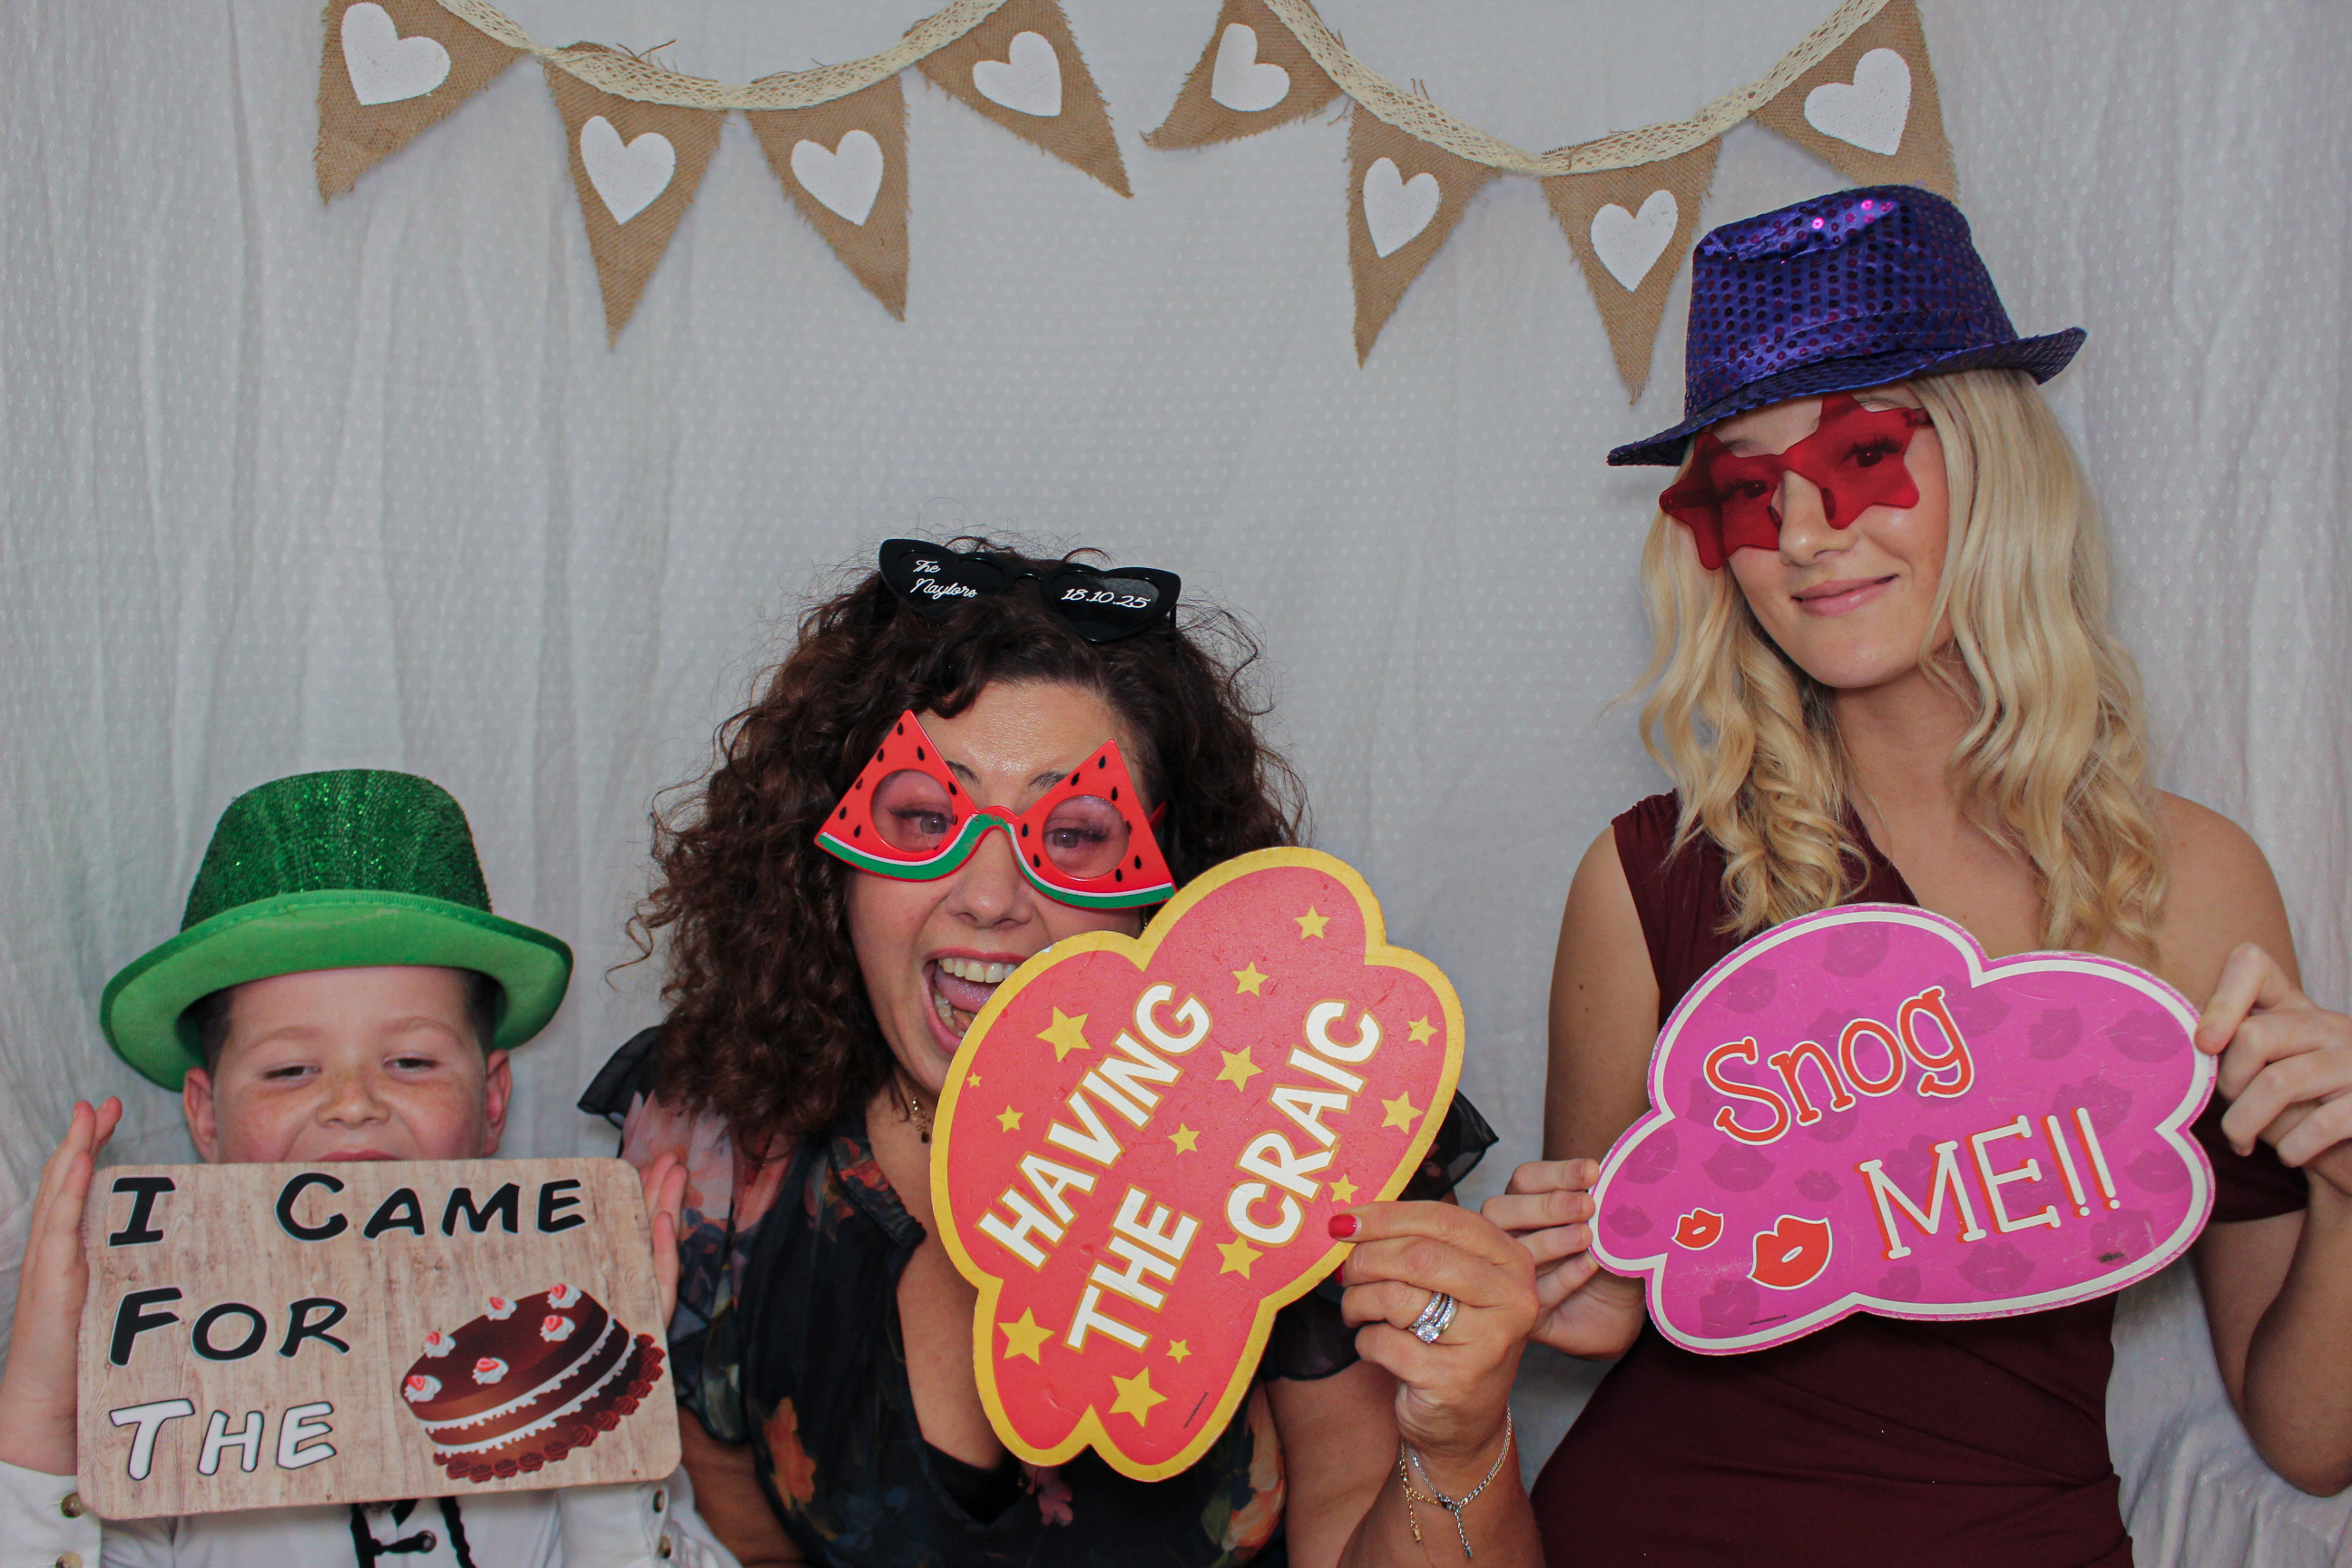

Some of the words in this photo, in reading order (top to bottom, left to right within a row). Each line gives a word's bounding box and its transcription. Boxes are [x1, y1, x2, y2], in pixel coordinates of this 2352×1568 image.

[910, 578, 977, 600] Naylors
[913, 560, 941, 573] The
[1061, 588, 1151, 608] 18.10.25
[1702, 985, 1974, 1145] Snog
[975, 984, 1211, 1269] HAVING
[1225, 999, 1382, 1247] CRAIC
[109, 1176, 176, 1247] I
[276, 1172, 585, 1241] CAME
[1854, 1107, 2122, 1259] ME!!
[1064, 1187, 1202, 1352] THE
[109, 1287, 350, 1367] FOR
[109, 1398, 337, 1481] THE
